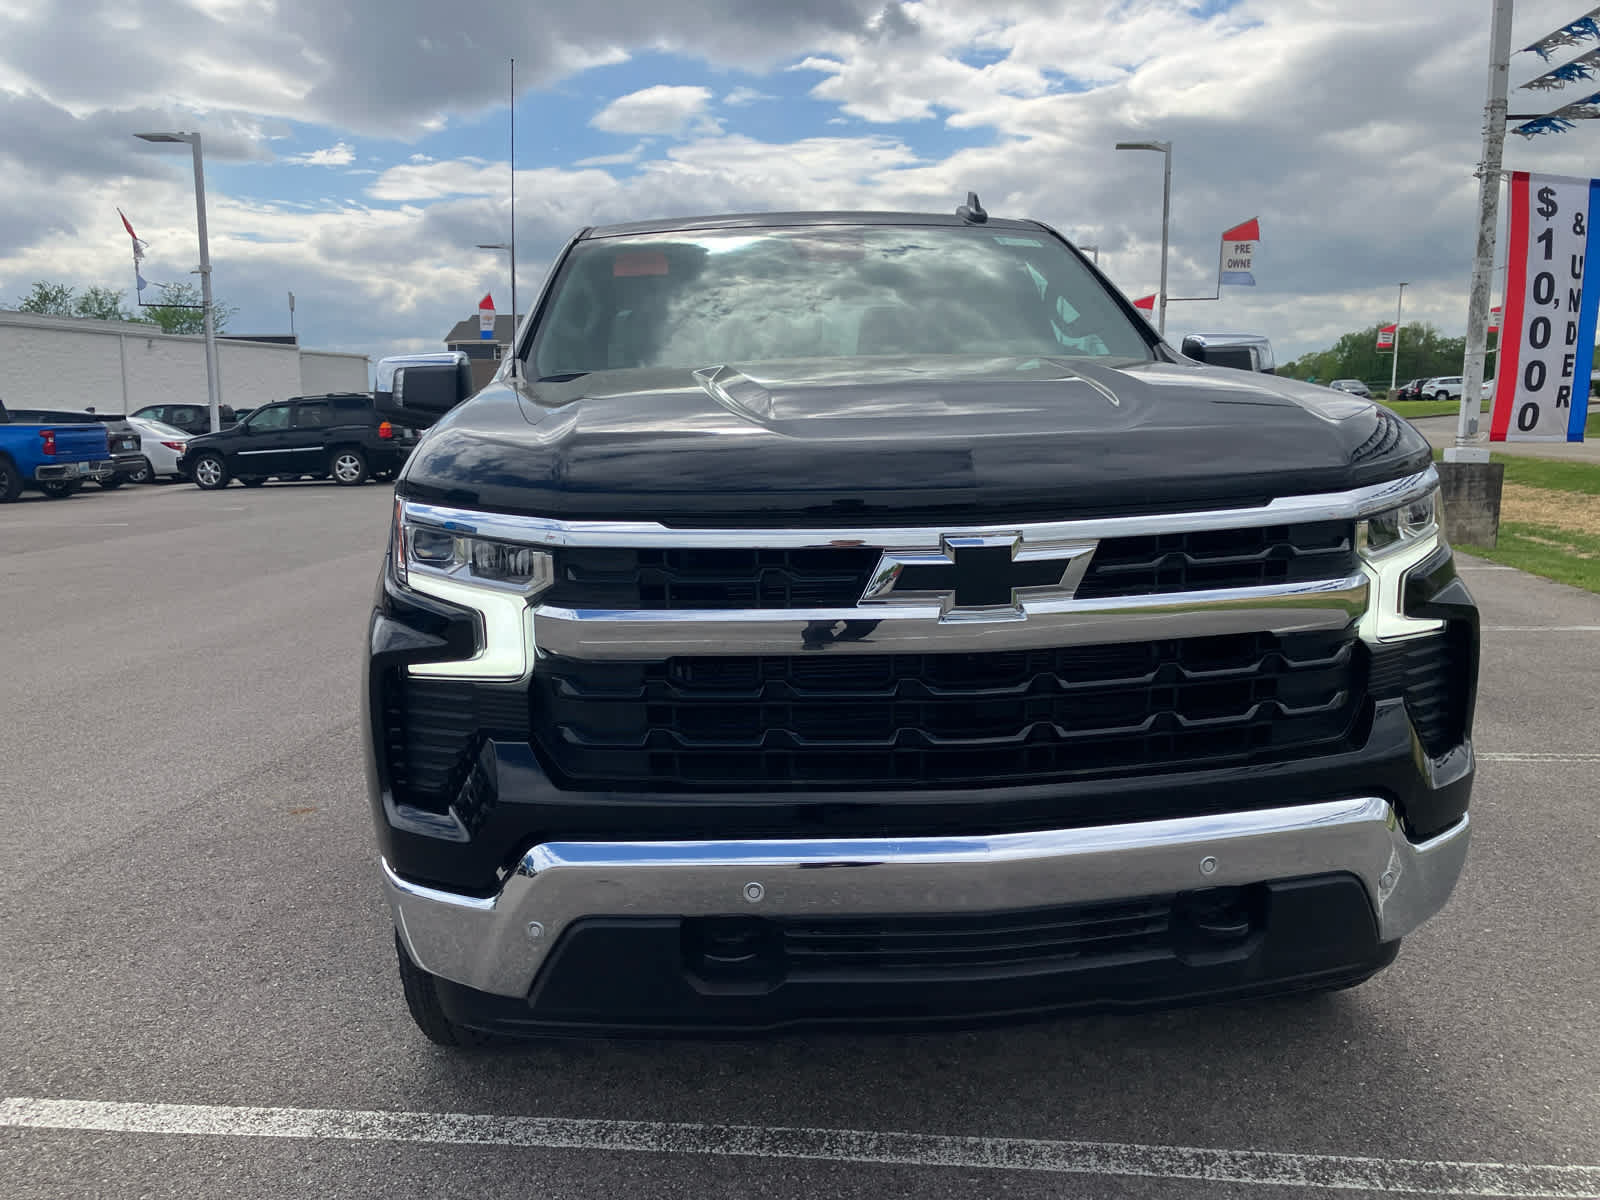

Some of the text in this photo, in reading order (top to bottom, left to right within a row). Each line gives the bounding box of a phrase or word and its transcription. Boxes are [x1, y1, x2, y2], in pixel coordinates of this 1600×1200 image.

[1234, 243, 1251, 254] PRE
[1517, 186, 1560, 432] $10,000
[1555, 212, 1586, 409] & UNDER
